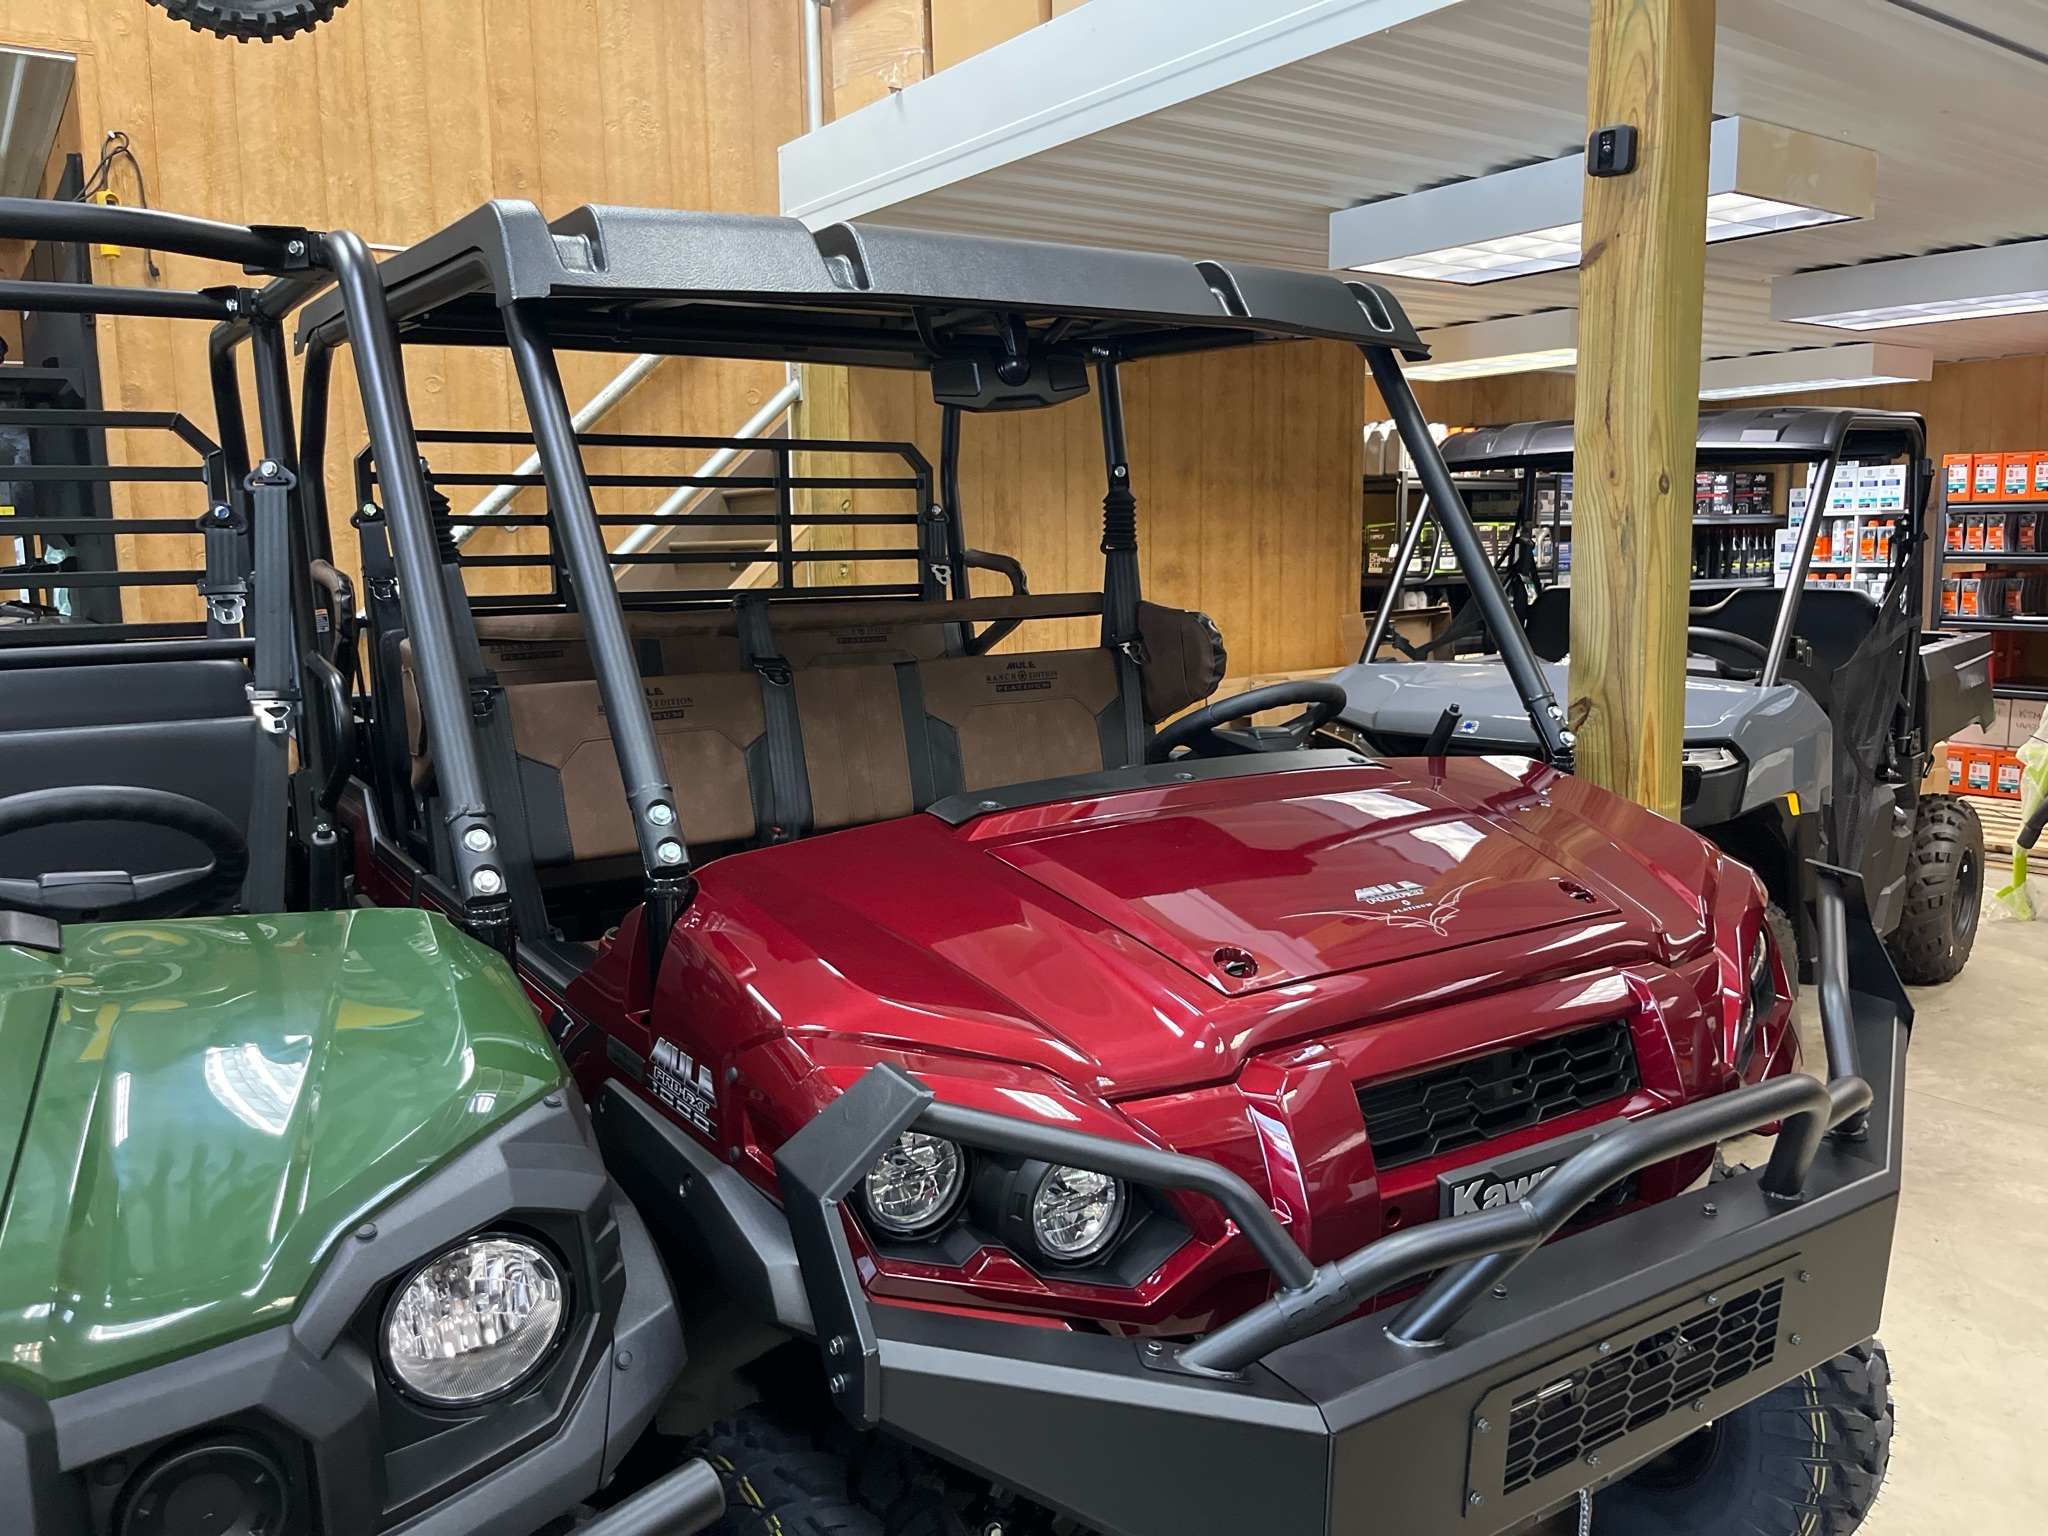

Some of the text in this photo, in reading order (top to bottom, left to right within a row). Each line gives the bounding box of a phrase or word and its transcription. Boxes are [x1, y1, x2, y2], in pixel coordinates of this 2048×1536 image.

[1006, 660, 1037, 670] MULE
[985, 670, 1058, 682] RANCH EDITION
[996, 682, 1051, 692] PLATINUM
[654, 697, 694, 708] EDITION
[2019, 708, 2041, 720] KTM
[1354, 880, 1427, 902] MULE
[1392, 902, 1433, 914] PLATINUM
[649, 1036, 717, 1109] MULE
[652, 1080, 710, 1133] 1000
